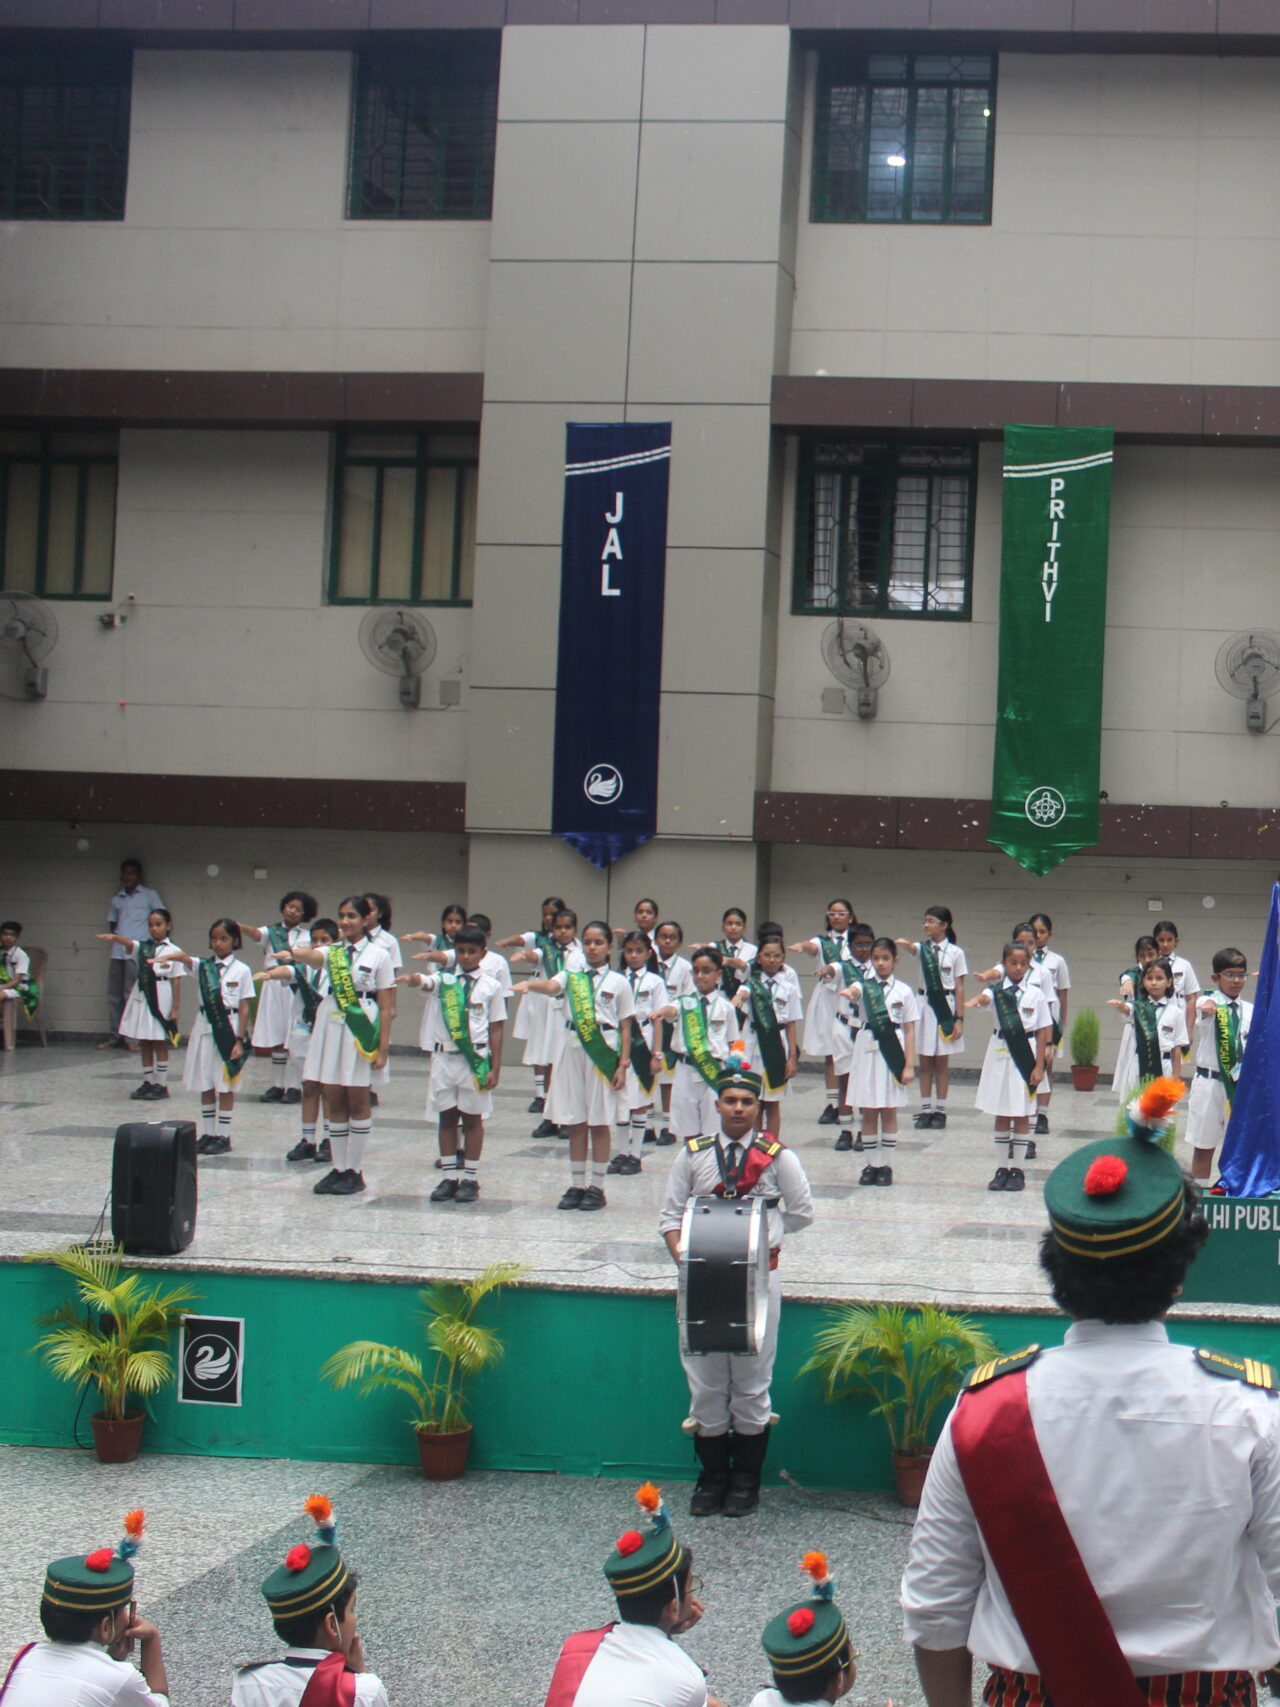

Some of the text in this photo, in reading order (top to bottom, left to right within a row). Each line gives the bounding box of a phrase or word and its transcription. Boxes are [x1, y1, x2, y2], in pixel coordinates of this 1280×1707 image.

[600, 491, 624, 596] JAL
[1041, 478, 1065, 622] PRITHVI
[340, 968, 357, 1003] HOUSE
[577, 1019, 592, 1042] AGNI
[581, 1000, 597, 1032] HOUSE
[1220, 1040, 1230, 1063] HEAD
